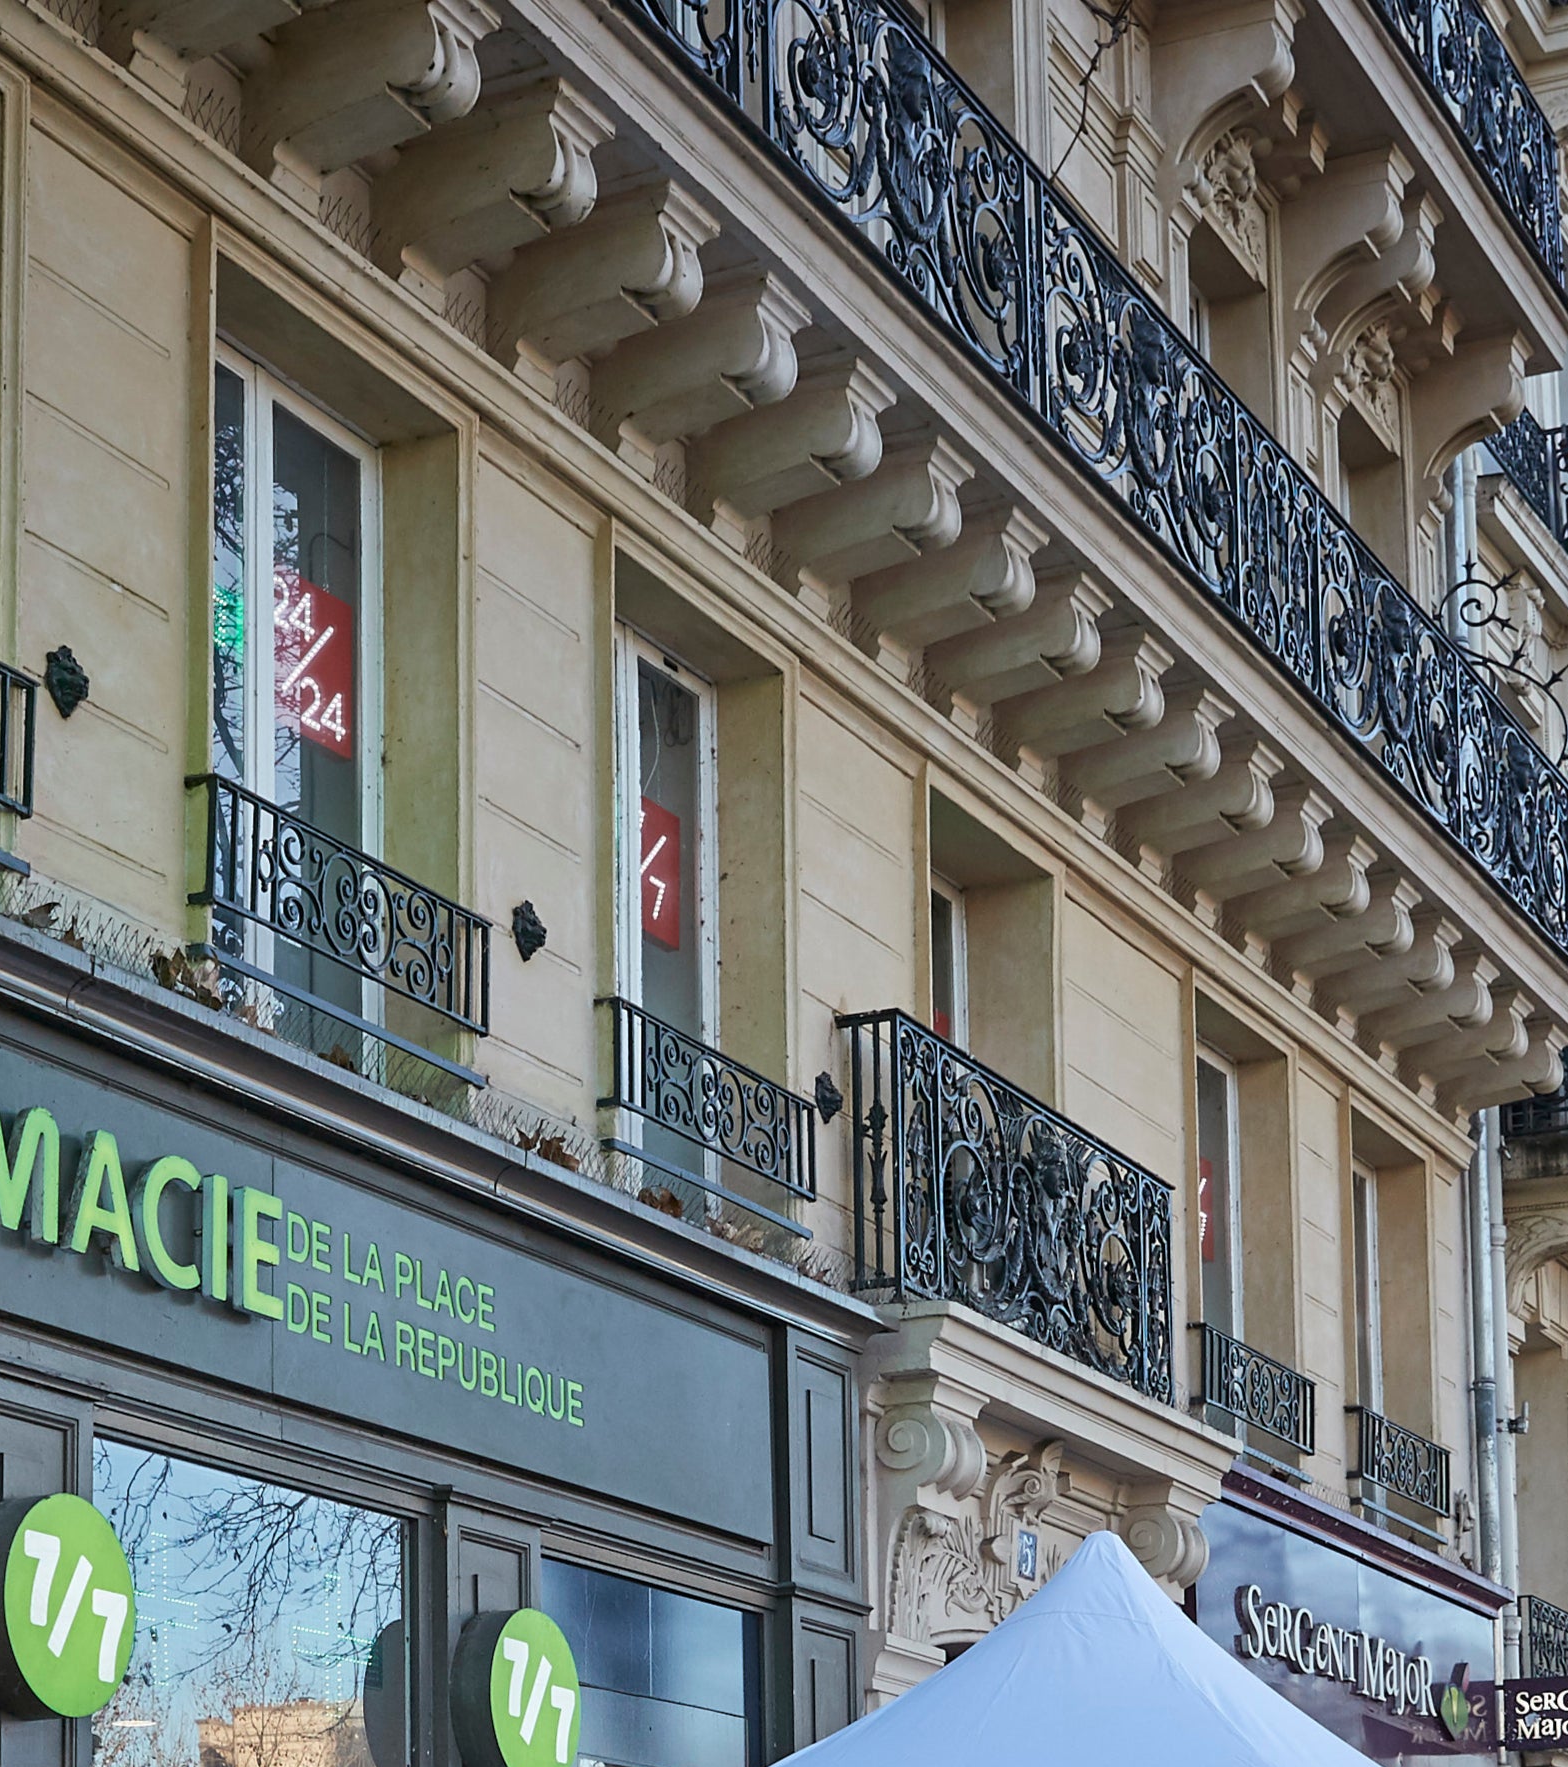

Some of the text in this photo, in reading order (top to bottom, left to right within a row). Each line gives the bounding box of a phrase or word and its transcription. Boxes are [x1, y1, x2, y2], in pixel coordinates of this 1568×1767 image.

[287, 1211, 496, 1333] DE LA PLACE
[287, 1282, 585, 1427] DE LA REPUBLIQUE
[25, 1529, 128, 1683] 7/7
[503, 1637, 576, 1764] 7/7
